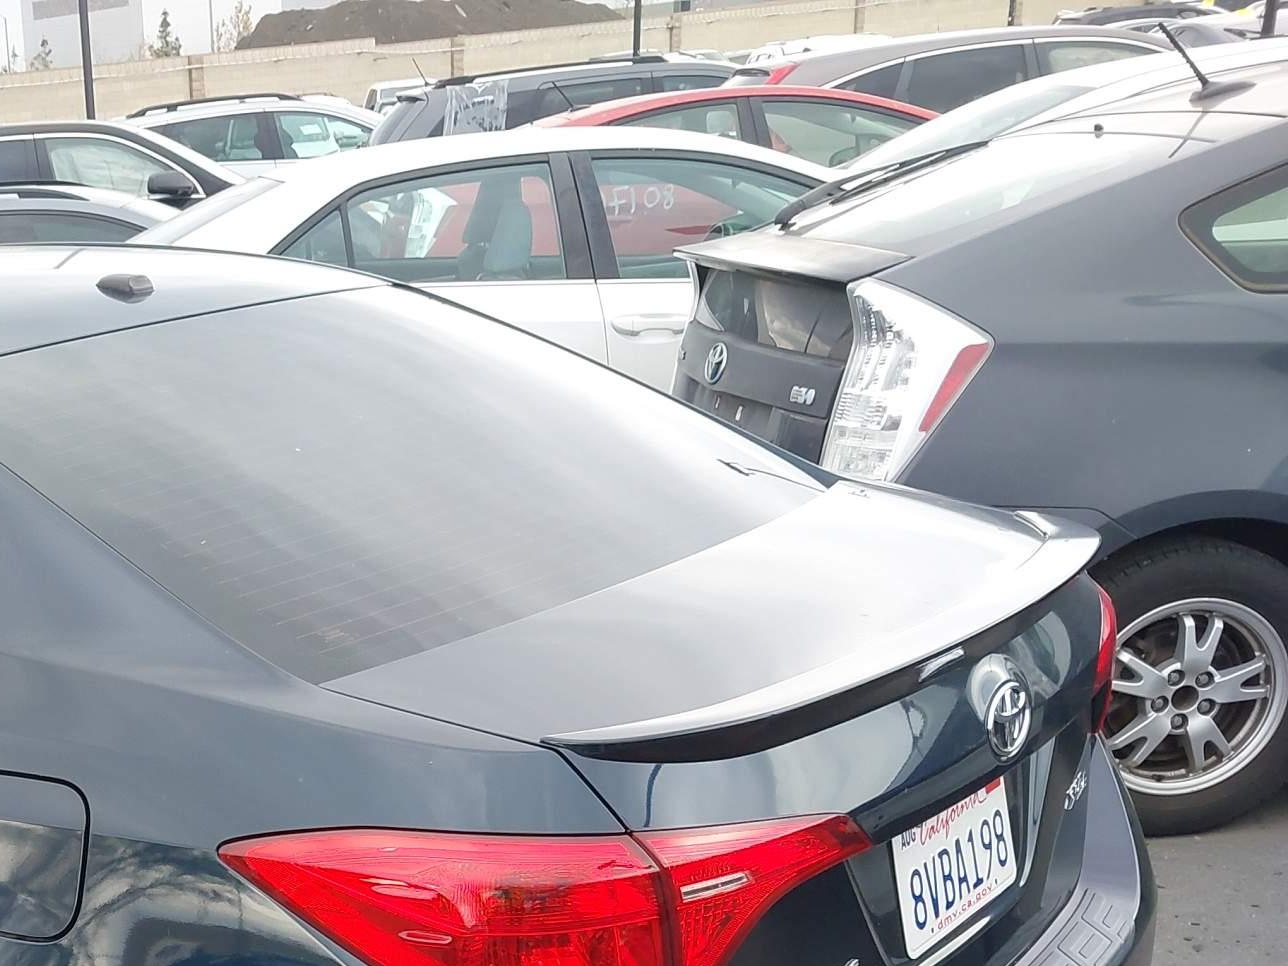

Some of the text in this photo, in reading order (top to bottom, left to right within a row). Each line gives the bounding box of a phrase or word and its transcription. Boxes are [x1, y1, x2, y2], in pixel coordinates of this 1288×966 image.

[901, 829, 916, 849] AUG
[910, 809, 1008, 930] 8VBA198
[937, 884, 993, 930] dmv.ca.gov
